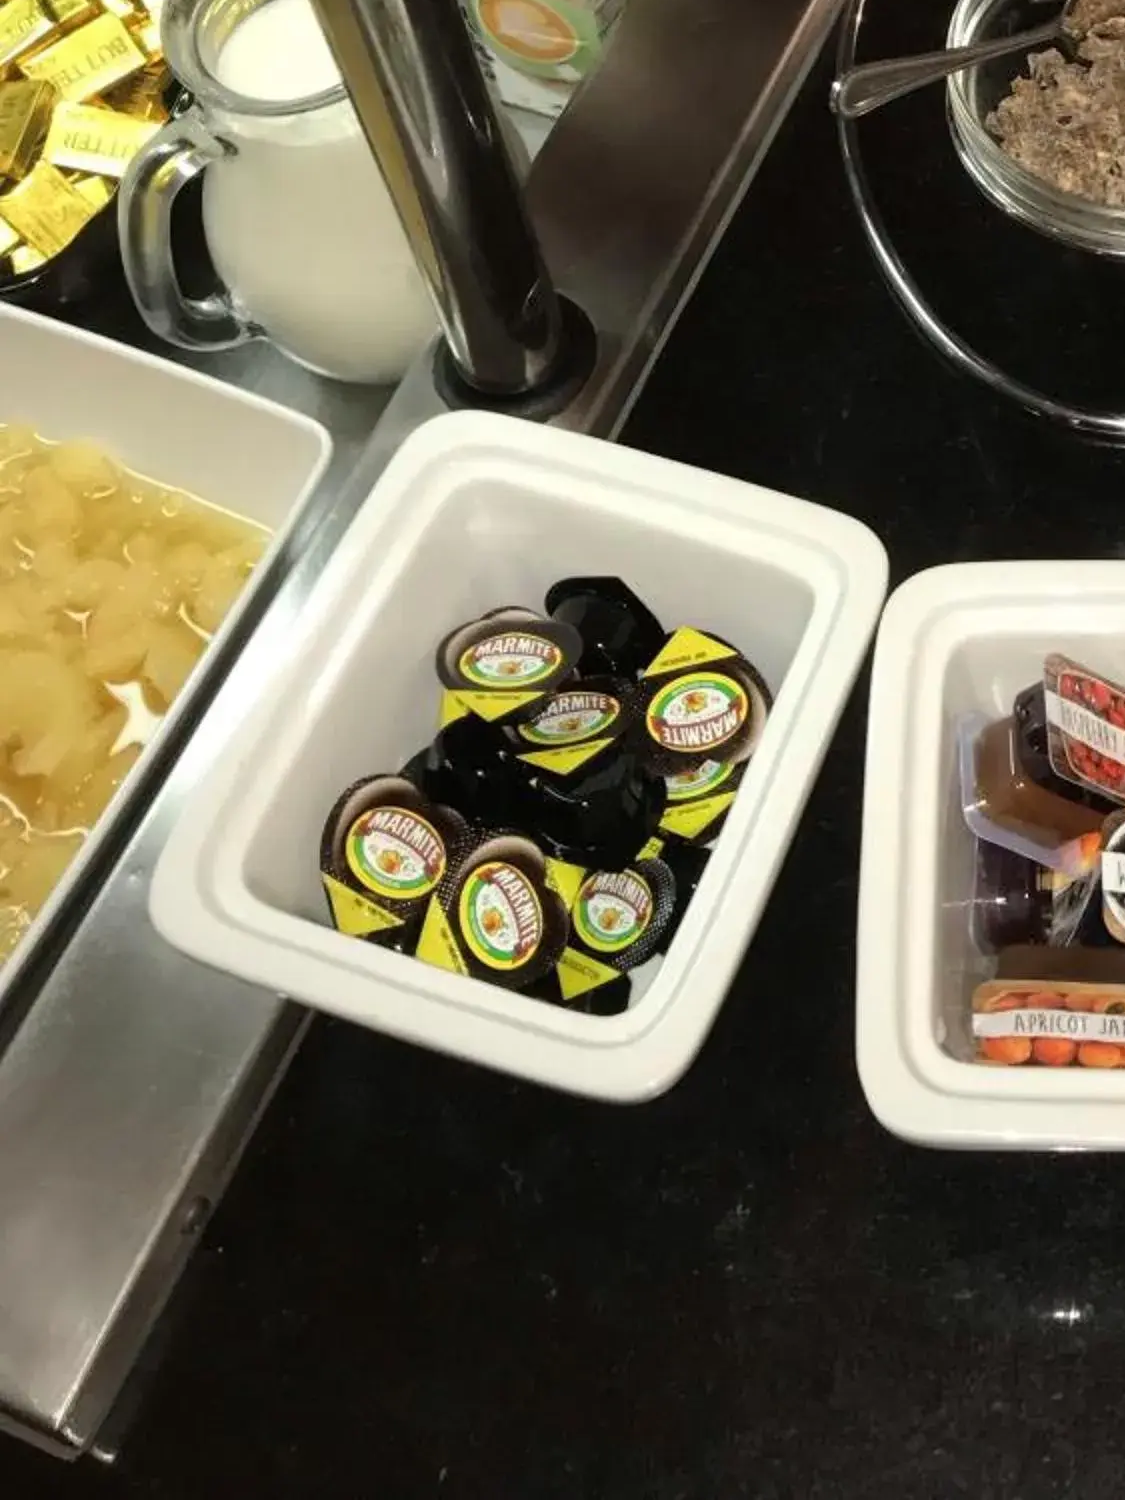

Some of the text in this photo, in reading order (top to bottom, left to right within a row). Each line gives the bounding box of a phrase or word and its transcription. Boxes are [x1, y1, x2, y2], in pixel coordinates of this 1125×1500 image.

[475, 637, 552, 657] MARMITE
[663, 708, 737, 745] MARMITE
[368, 812, 439, 867] MARMITE
[492, 868, 539, 944] MARMITE
[1014, 1012, 1089, 1034] APRICOT
